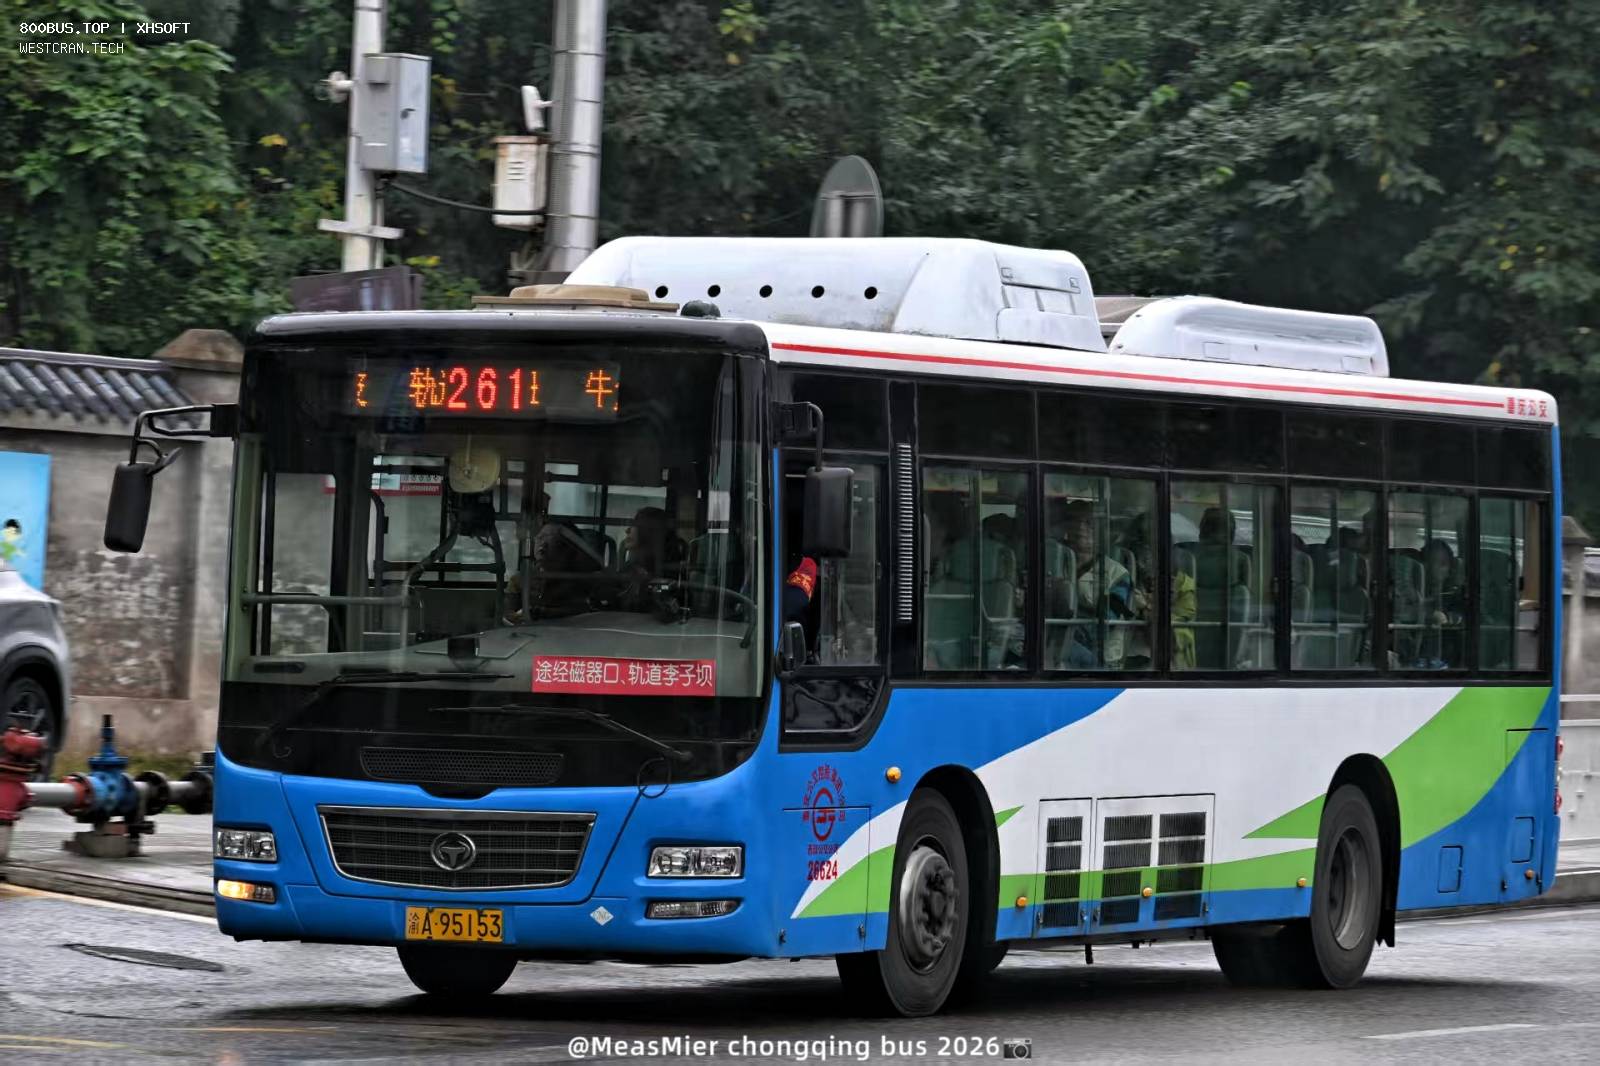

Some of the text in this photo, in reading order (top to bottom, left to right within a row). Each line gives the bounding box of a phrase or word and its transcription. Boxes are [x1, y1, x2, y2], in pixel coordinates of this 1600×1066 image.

[448, 367, 527, 409] 261
[585, 369, 620, 411] 牛
[535, 660, 713, 687] 途经磁器口、轨道李子坝
